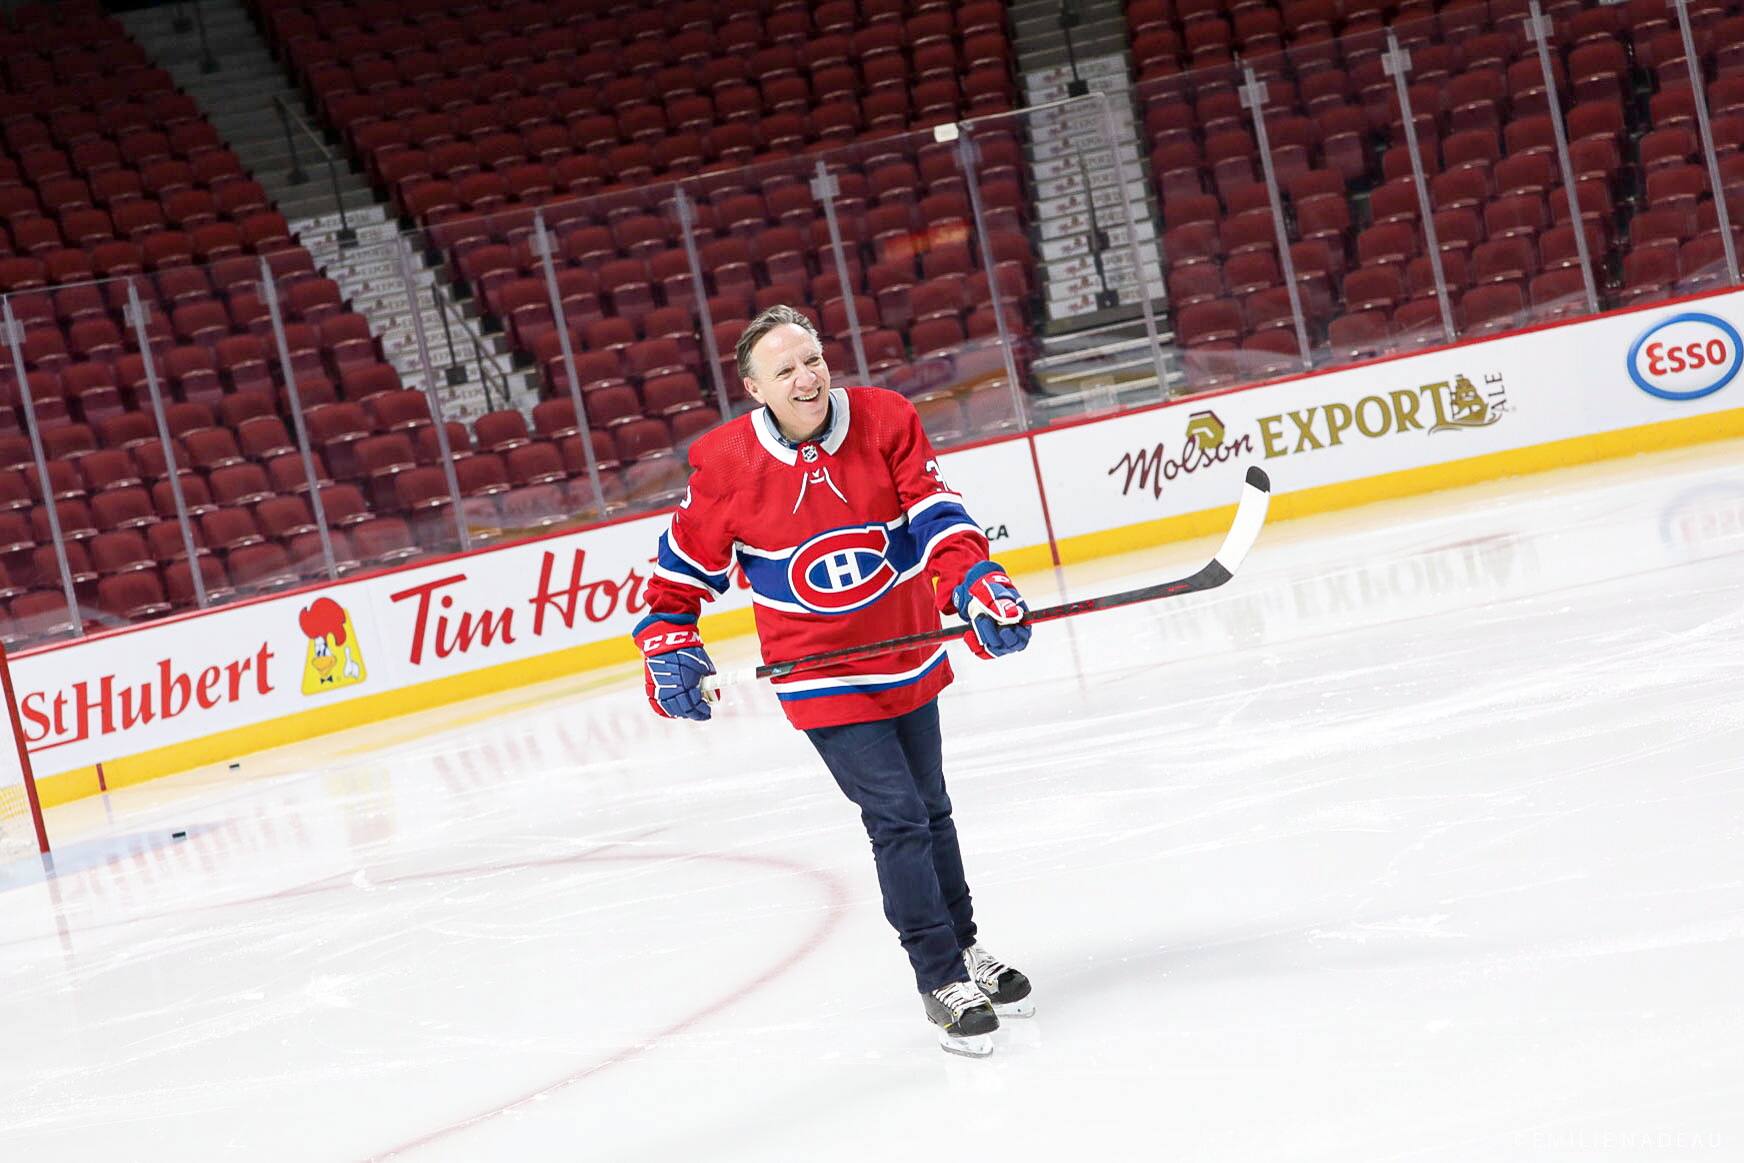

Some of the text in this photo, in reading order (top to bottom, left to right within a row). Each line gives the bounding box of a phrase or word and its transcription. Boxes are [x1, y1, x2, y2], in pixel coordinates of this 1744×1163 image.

[1484, 372, 1509, 413] ALE
[1108, 381, 1450, 500] Molson EXPORT
[389, 573, 517, 666] Tim
